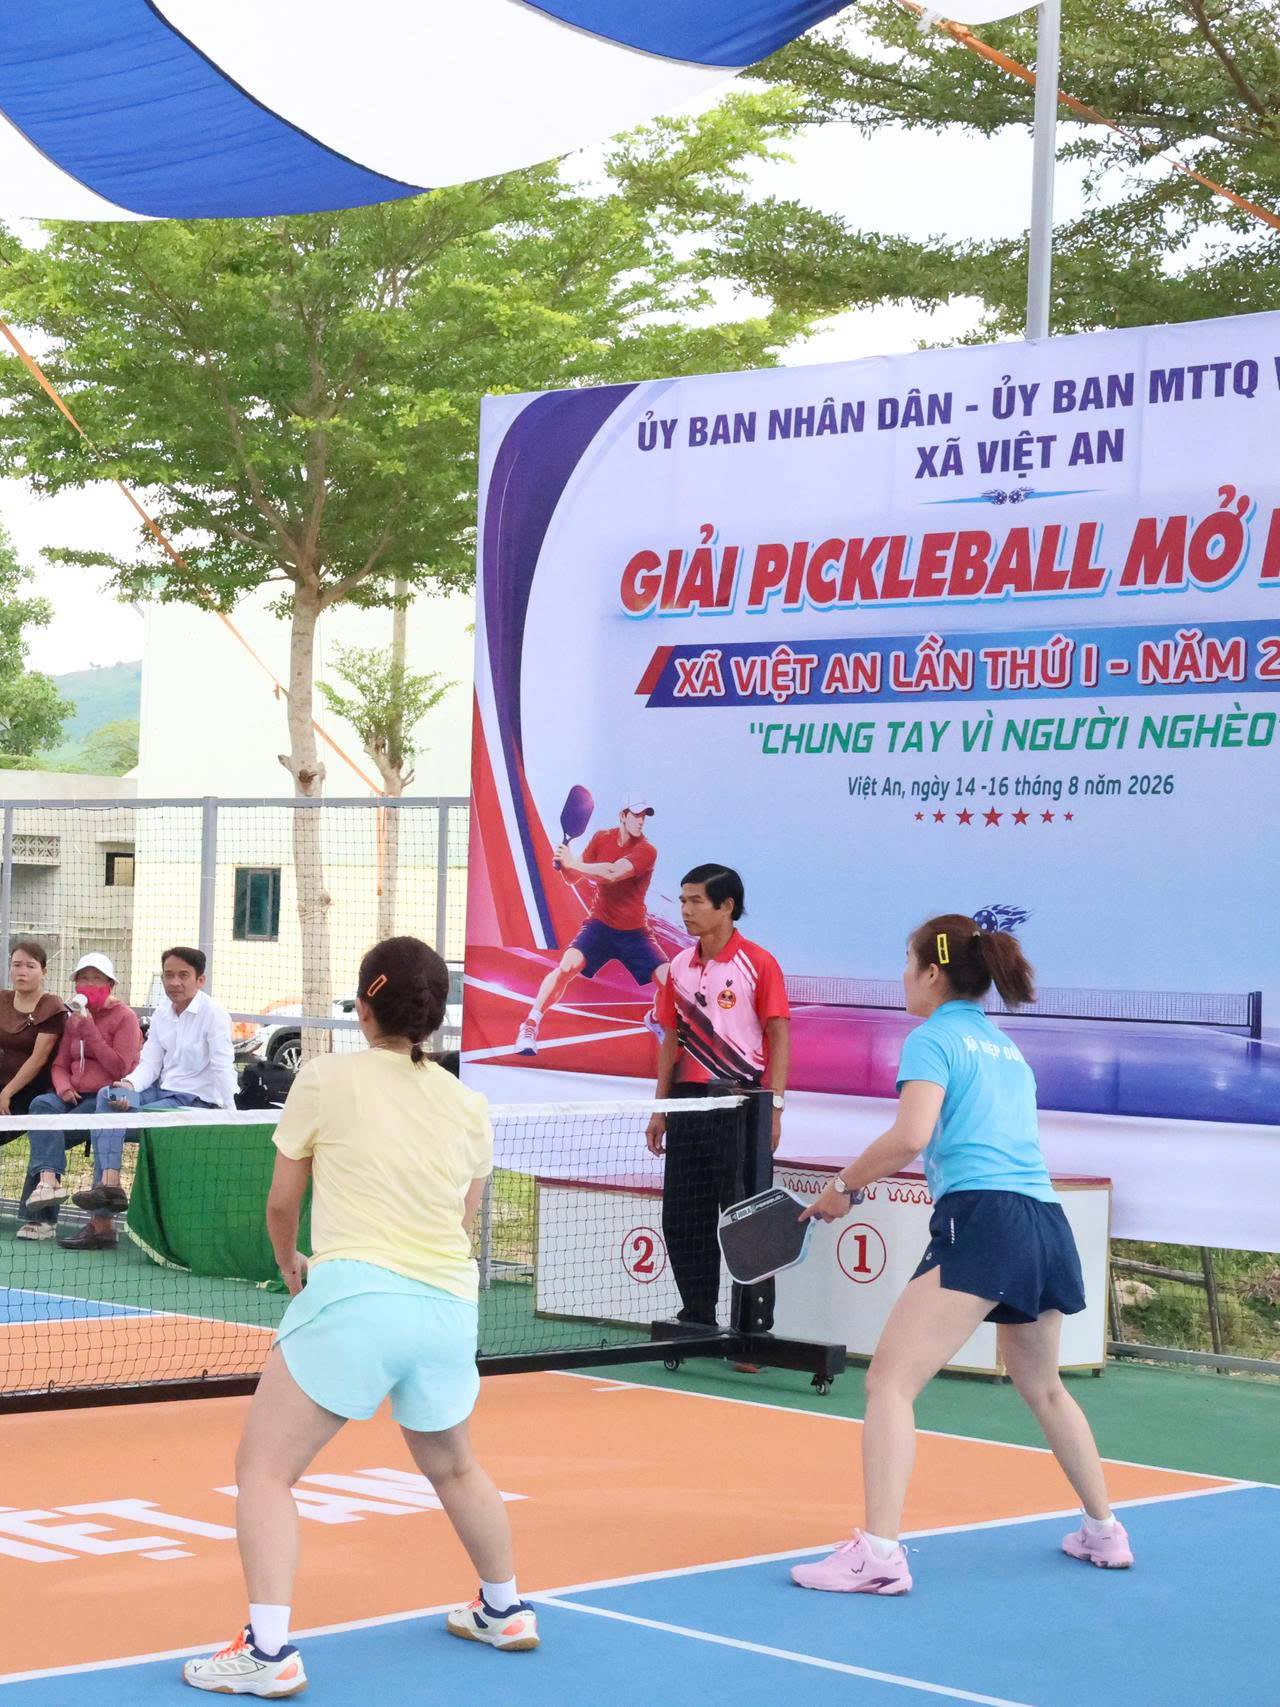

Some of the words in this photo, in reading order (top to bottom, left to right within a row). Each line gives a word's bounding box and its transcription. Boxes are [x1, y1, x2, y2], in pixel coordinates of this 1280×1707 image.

[637, 410, 678, 451] ỦY
[688, 411, 756, 447] BAN
[768, 397, 865, 440] NHÂN
[877, 388, 952, 430] DÂN
[992, 374, 1040, 419] ỦY
[1053, 372, 1134, 414] BAN
[1148, 359, 1260, 404] MTTQ
[914, 436, 964, 479] XÃ
[977, 430, 1057, 479] VIỆT
[1068, 428, 1125, 466] AN
[619, 523, 740, 613] GIẢI
[747, 521, 1107, 607] PICKLEBALL
[1119, 484, 1251, 587] MỞ
[675, 651, 724, 696] XÃ
[733, 646, 816, 703] VIỆT
[824, 653, 880, 694] AN
[891, 633, 972, 691] LẦN
[982, 634, 1074, 688] THỨ
[1082, 644, 1097, 686] I
[1139, 629, 1244, 683] NĂM
[886, 720, 951, 753] TAY
[961, 709, 994, 752] VÌ
[1001, 706, 1129, 751] NGƯỜI
[1138, 701, 1280, 749] NGHÈO
[848, 776, 878, 800] Việt
[881, 778, 906, 799] An,
[911, 775, 950, 801] ngày
[955, 777, 976, 796] 14
[1015, 774, 1062, 801] tháng
[1069, 776, 1079, 795] 8
[1084, 774, 1121, 796] năm
[1127, 775, 1174, 795] 2026
[633, 1235, 654, 1274] 2
[852, 1234, 871, 1274] 1
